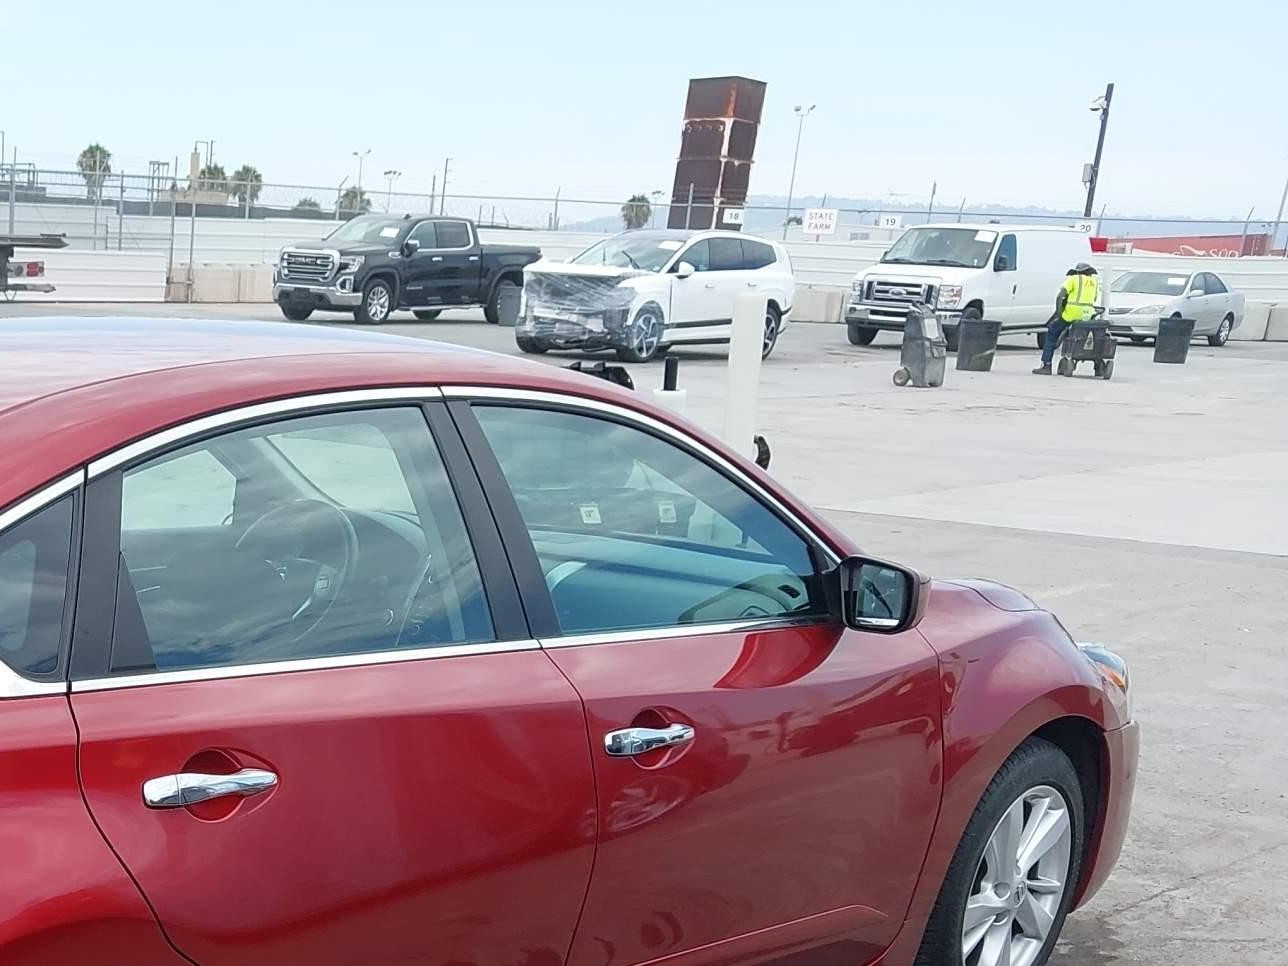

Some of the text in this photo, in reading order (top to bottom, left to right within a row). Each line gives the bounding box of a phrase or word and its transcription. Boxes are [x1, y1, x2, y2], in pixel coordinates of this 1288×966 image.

[729, 212, 739, 220] 18
[808, 212, 833, 221] STATE
[885, 217, 896, 226] 19
[807, 222, 831, 231] FARM
